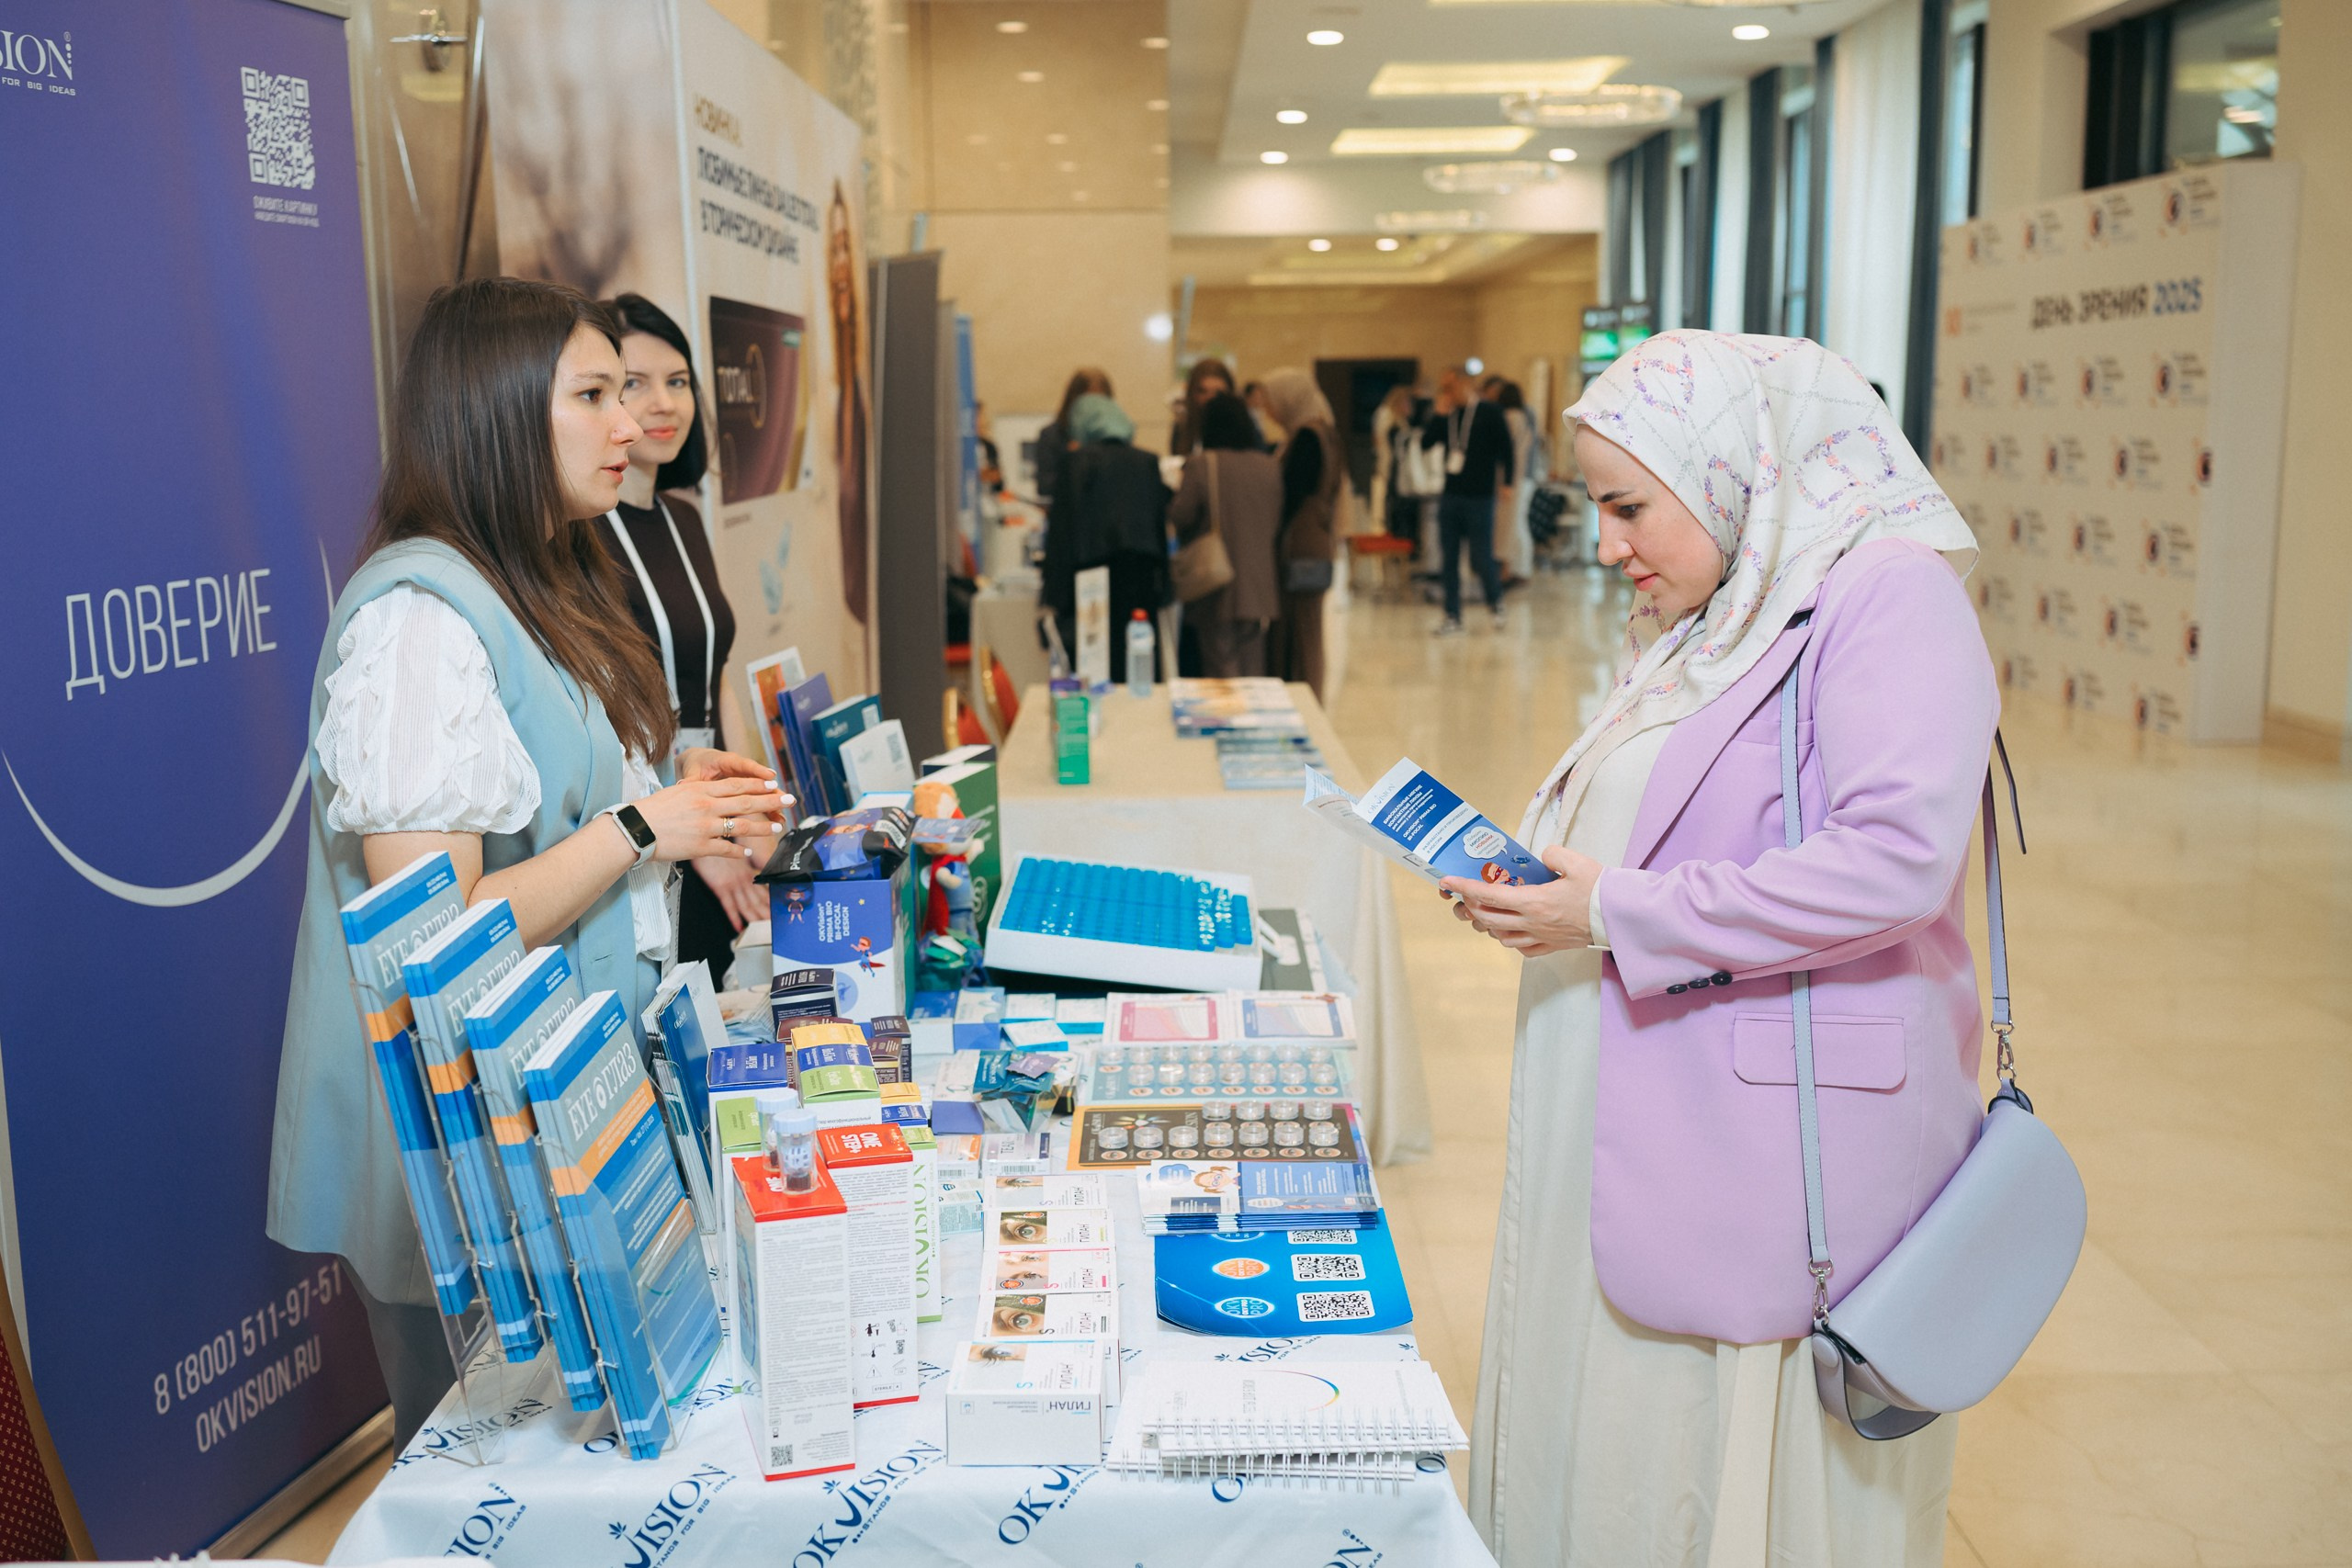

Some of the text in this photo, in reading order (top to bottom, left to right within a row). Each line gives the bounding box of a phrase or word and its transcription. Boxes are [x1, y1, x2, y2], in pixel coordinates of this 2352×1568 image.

[2, 76, 76, 96] FOR BIG IDEAS
[2031, 295, 2073, 329] ДЕНЬ
[2078, 283, 2149, 322] ЗРЕНИЯ
[2154, 276, 2202, 316] 2025
[66, 568, 277, 701] ДОВЕРИЕ
[1384, 784, 1423, 824] БИФОКАЛЬНЫЕ МЯГКИЕ
[1387, 792, 1423, 828] КОНТАКТНЫЕ ЛИНЗЫ
[1419, 809, 1431, 820] PRIMA
[1407, 824, 1424, 840] BI-FOCAL
[826, 915, 834, 943] PRIMA
[834, 903, 842, 941] BI-FOCAL
[567, 1091, 599, 1142] EYE
[841, 1134, 862, 1155] STEP+
[860, 1132, 883, 1148] ONE
[913, 1164, 930, 1299] OKVISION
[153, 1259, 342, 1415] 8 (800) 511-97-51
[195, 1334, 322, 1453] OKVISION.RU
[527, 1405, 553, 1418] IDEAS
[681, 1518, 695, 1535] FOR
[696, 1498, 710, 1514] BIG
[713, 1475, 737, 1493] IDEAS
[862, 1495, 891, 1530] STANDS
[492, 1505, 526, 1550] BIG IDEAS
